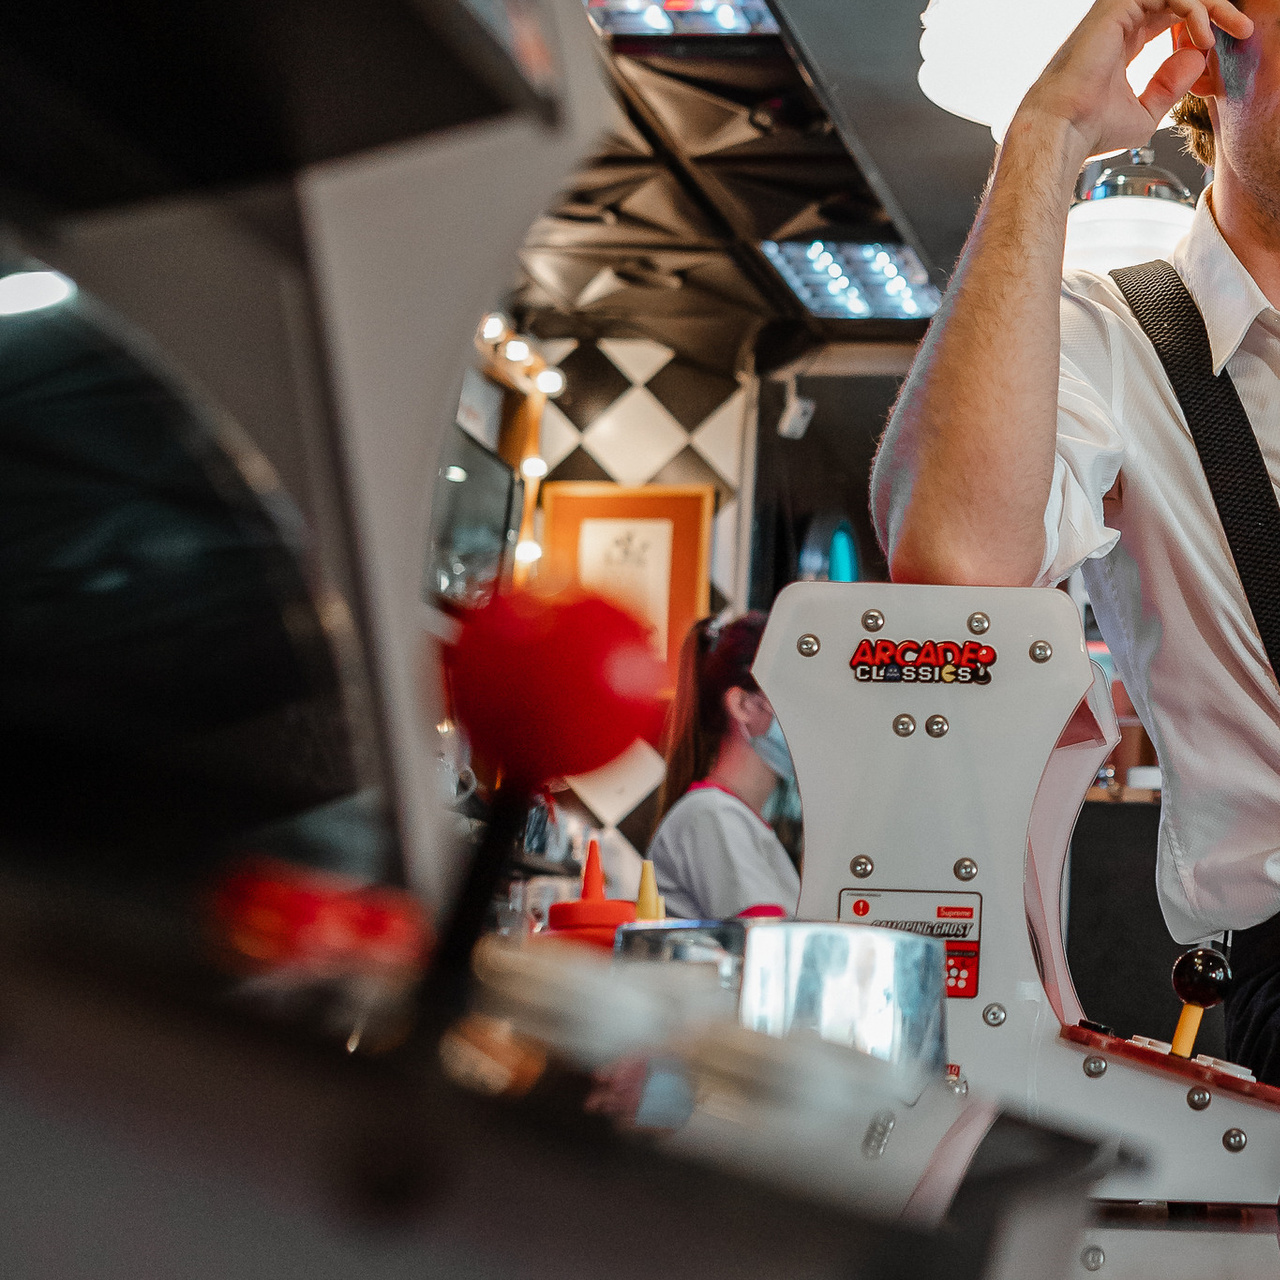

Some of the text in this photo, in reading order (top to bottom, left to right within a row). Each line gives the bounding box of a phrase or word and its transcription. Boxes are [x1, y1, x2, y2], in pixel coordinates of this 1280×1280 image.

[850, 639, 981, 669] ARCADE
[940, 907, 972, 918] Supreme
[932, 922, 974, 938] GHOST
